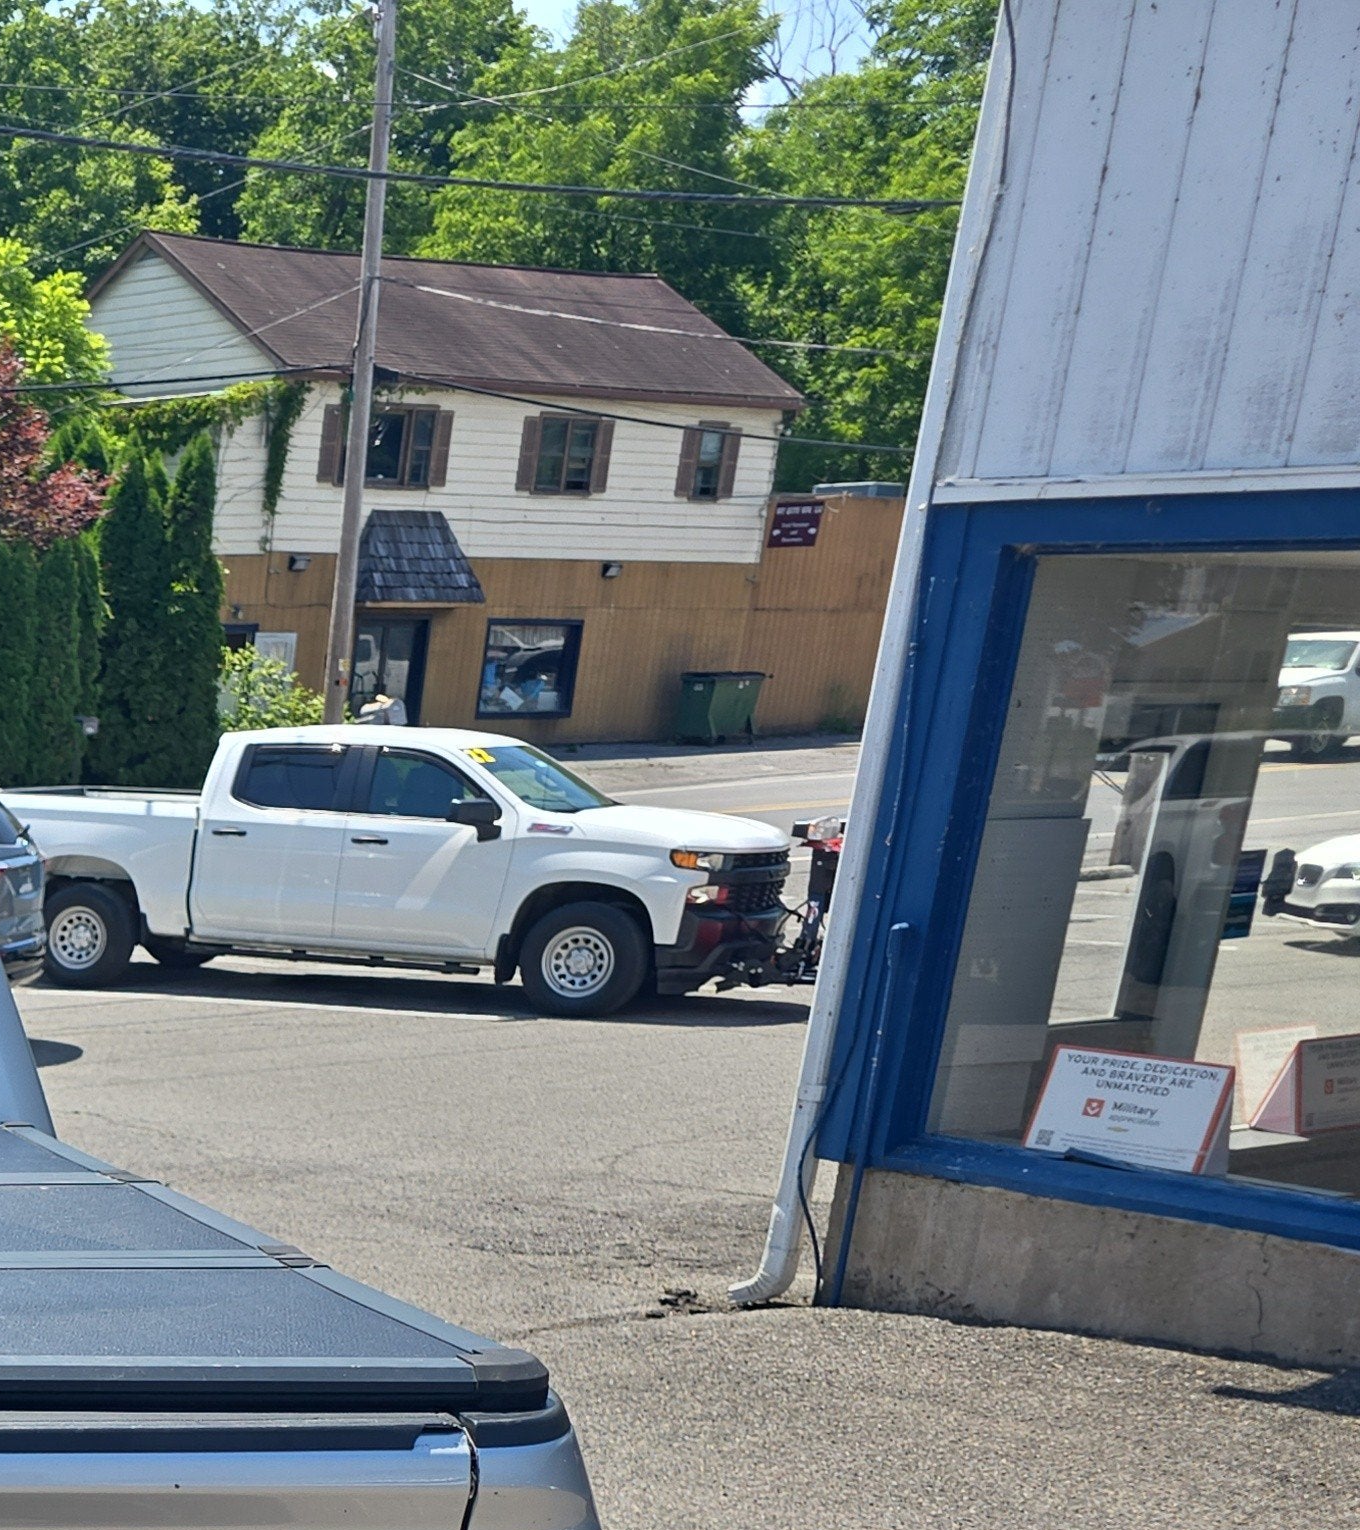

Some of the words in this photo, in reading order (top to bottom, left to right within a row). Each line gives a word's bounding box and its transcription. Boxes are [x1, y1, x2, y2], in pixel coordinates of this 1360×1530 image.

[1067, 1053, 1099, 1066] YOUR
[1081, 1067, 1106, 1078] AND
[1108, 1070, 1167, 1085] BRAVERY
[1169, 1077, 1196, 1089] ARE
[1095, 1079, 1171, 1098] UNMATCHED
[1110, 1100, 1159, 1119] Military
